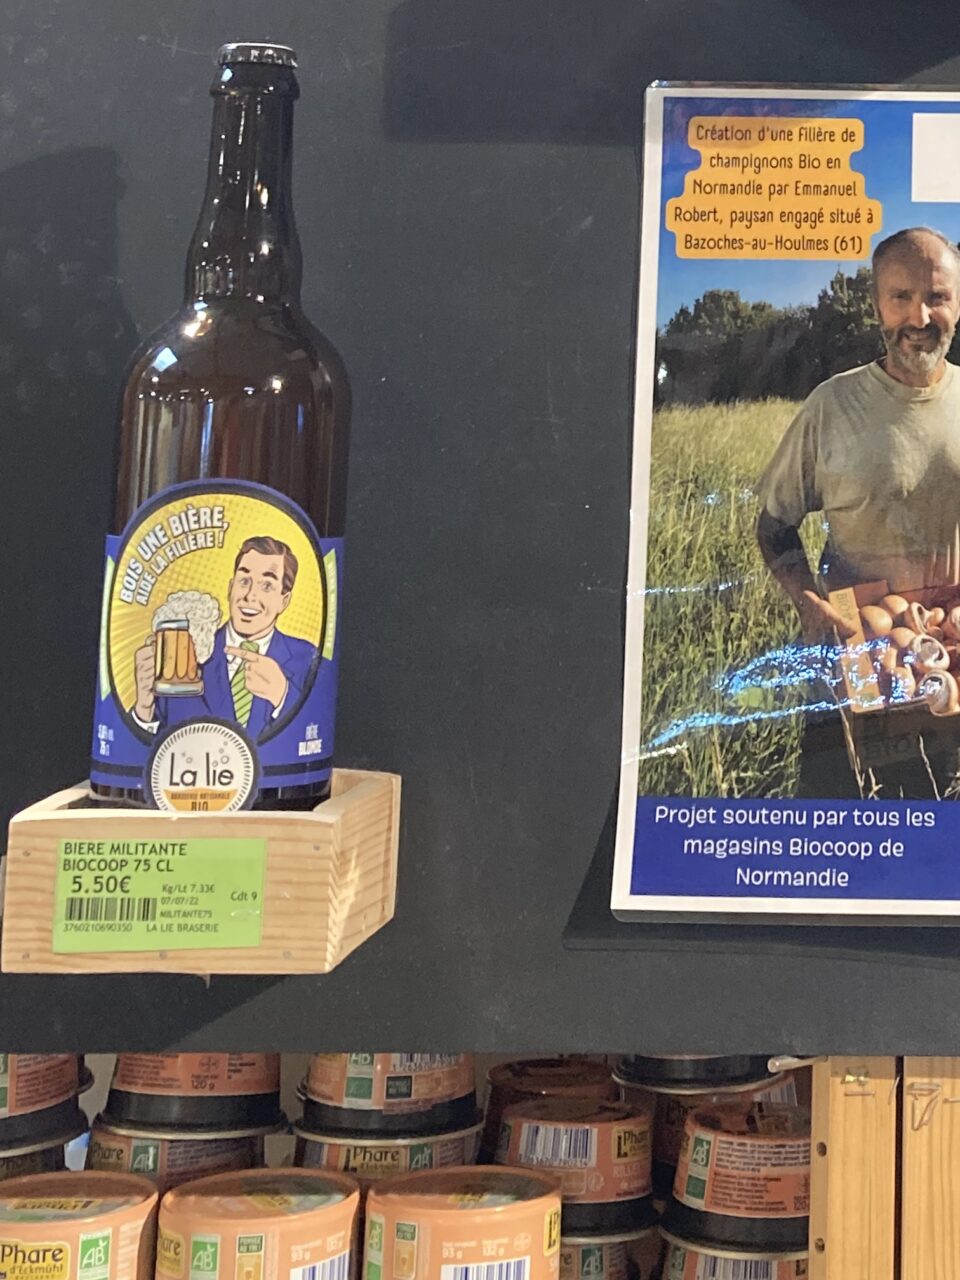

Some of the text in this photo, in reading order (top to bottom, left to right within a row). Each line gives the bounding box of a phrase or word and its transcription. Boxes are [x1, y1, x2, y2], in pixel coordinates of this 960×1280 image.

[696, 125, 856, 142] Création d'une filière de
[710, 153, 841, 174] champignons Bio en
[693, 180, 857, 201] Normandie par Emmanuel
[674, 207, 874, 229] Robert, paysan engagé situé à
[685, 234, 863, 253] Bazoches-au-Houlmes (61)
[170, 752, 234, 786] La lie
[655, 806, 935, 829] Projet soutenu par tous les
[64, 842, 187, 856] BIERE MILITANTE
[684, 837, 904, 860] magasins Biocoop de
[63, 859, 174, 872] BIOCOOP 75 CL
[71, 875, 131, 894] 5.50€
[736, 868, 849, 886] Normandie
[353, 1146, 399, 1162] Phare
[1, 1244, 64, 1264] Phare
